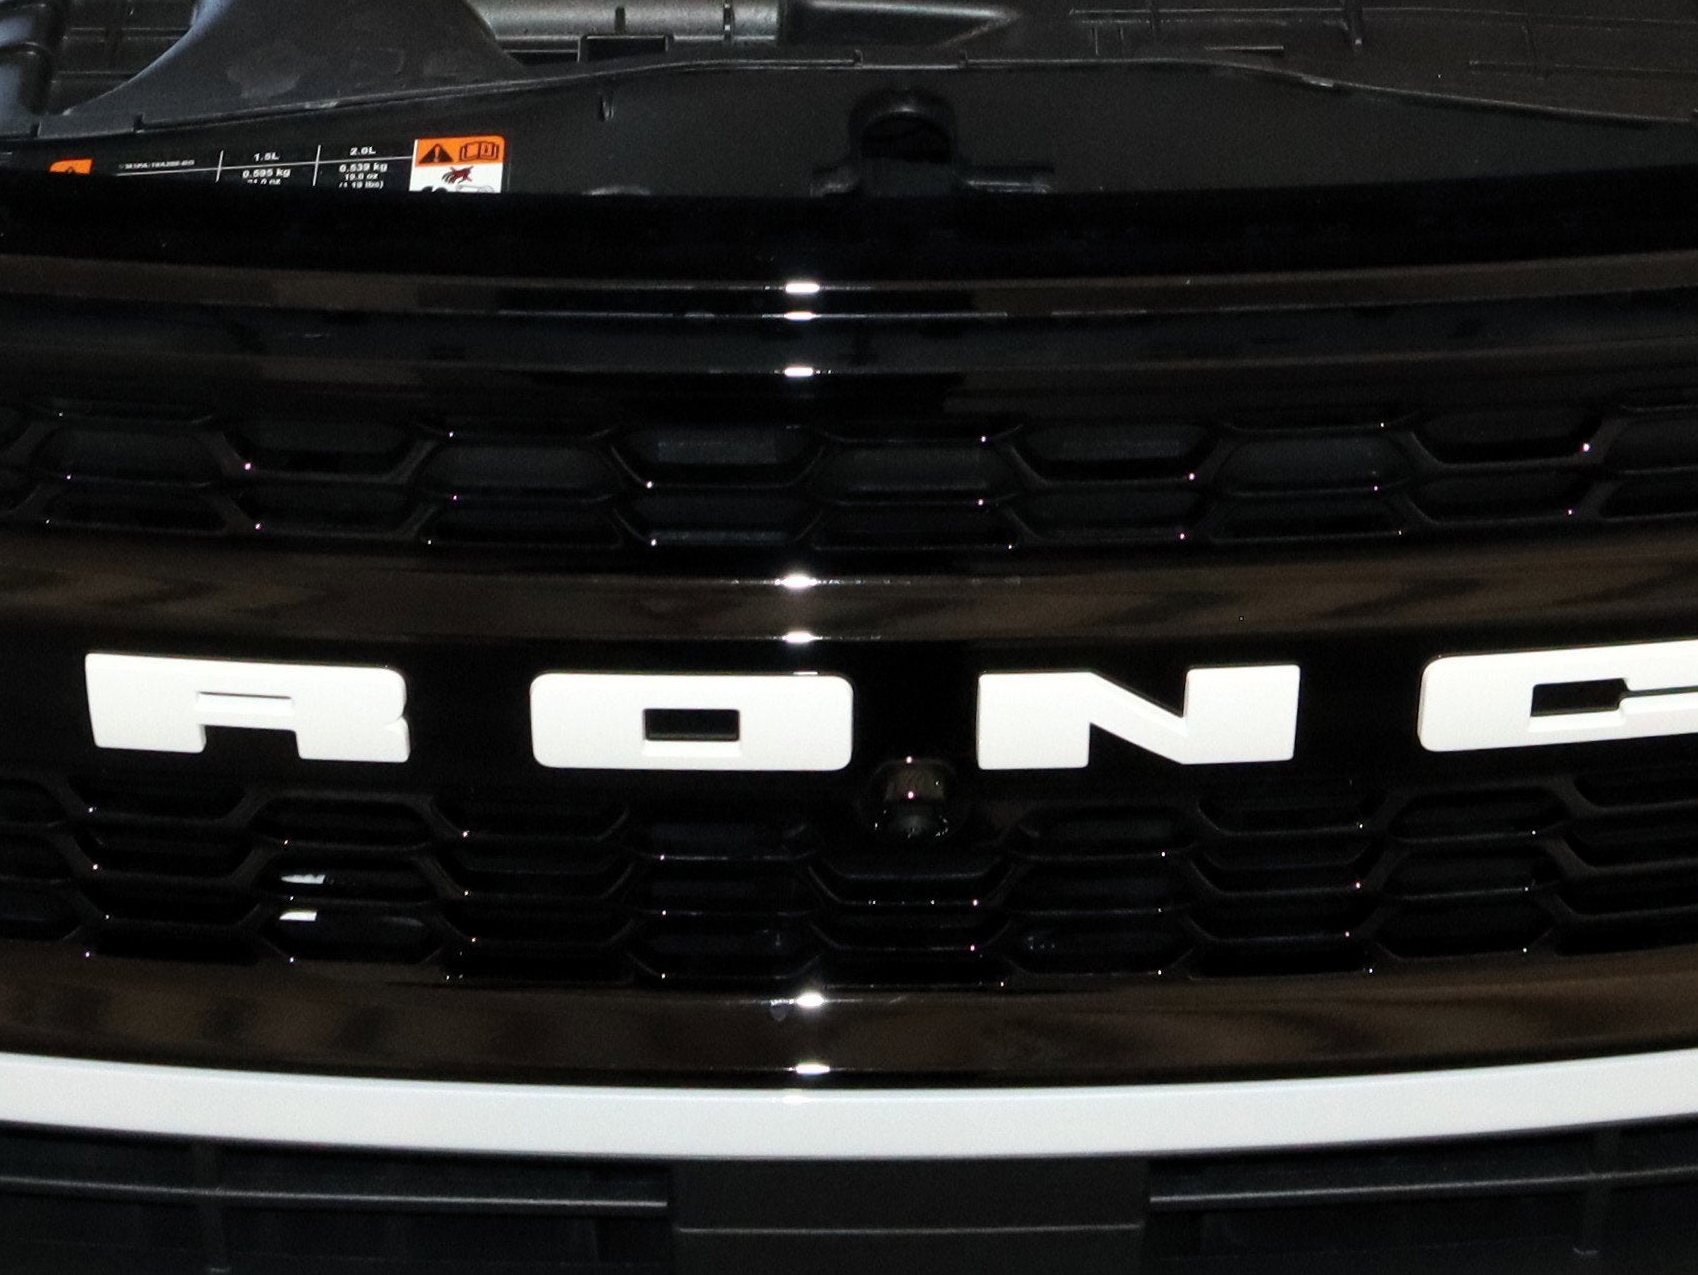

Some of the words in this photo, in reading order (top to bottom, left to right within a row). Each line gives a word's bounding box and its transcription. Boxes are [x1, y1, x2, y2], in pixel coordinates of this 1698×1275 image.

[349, 146, 377, 156] 2.0L
[276, 167, 292, 179] kg
[373, 162, 388, 173] kg
